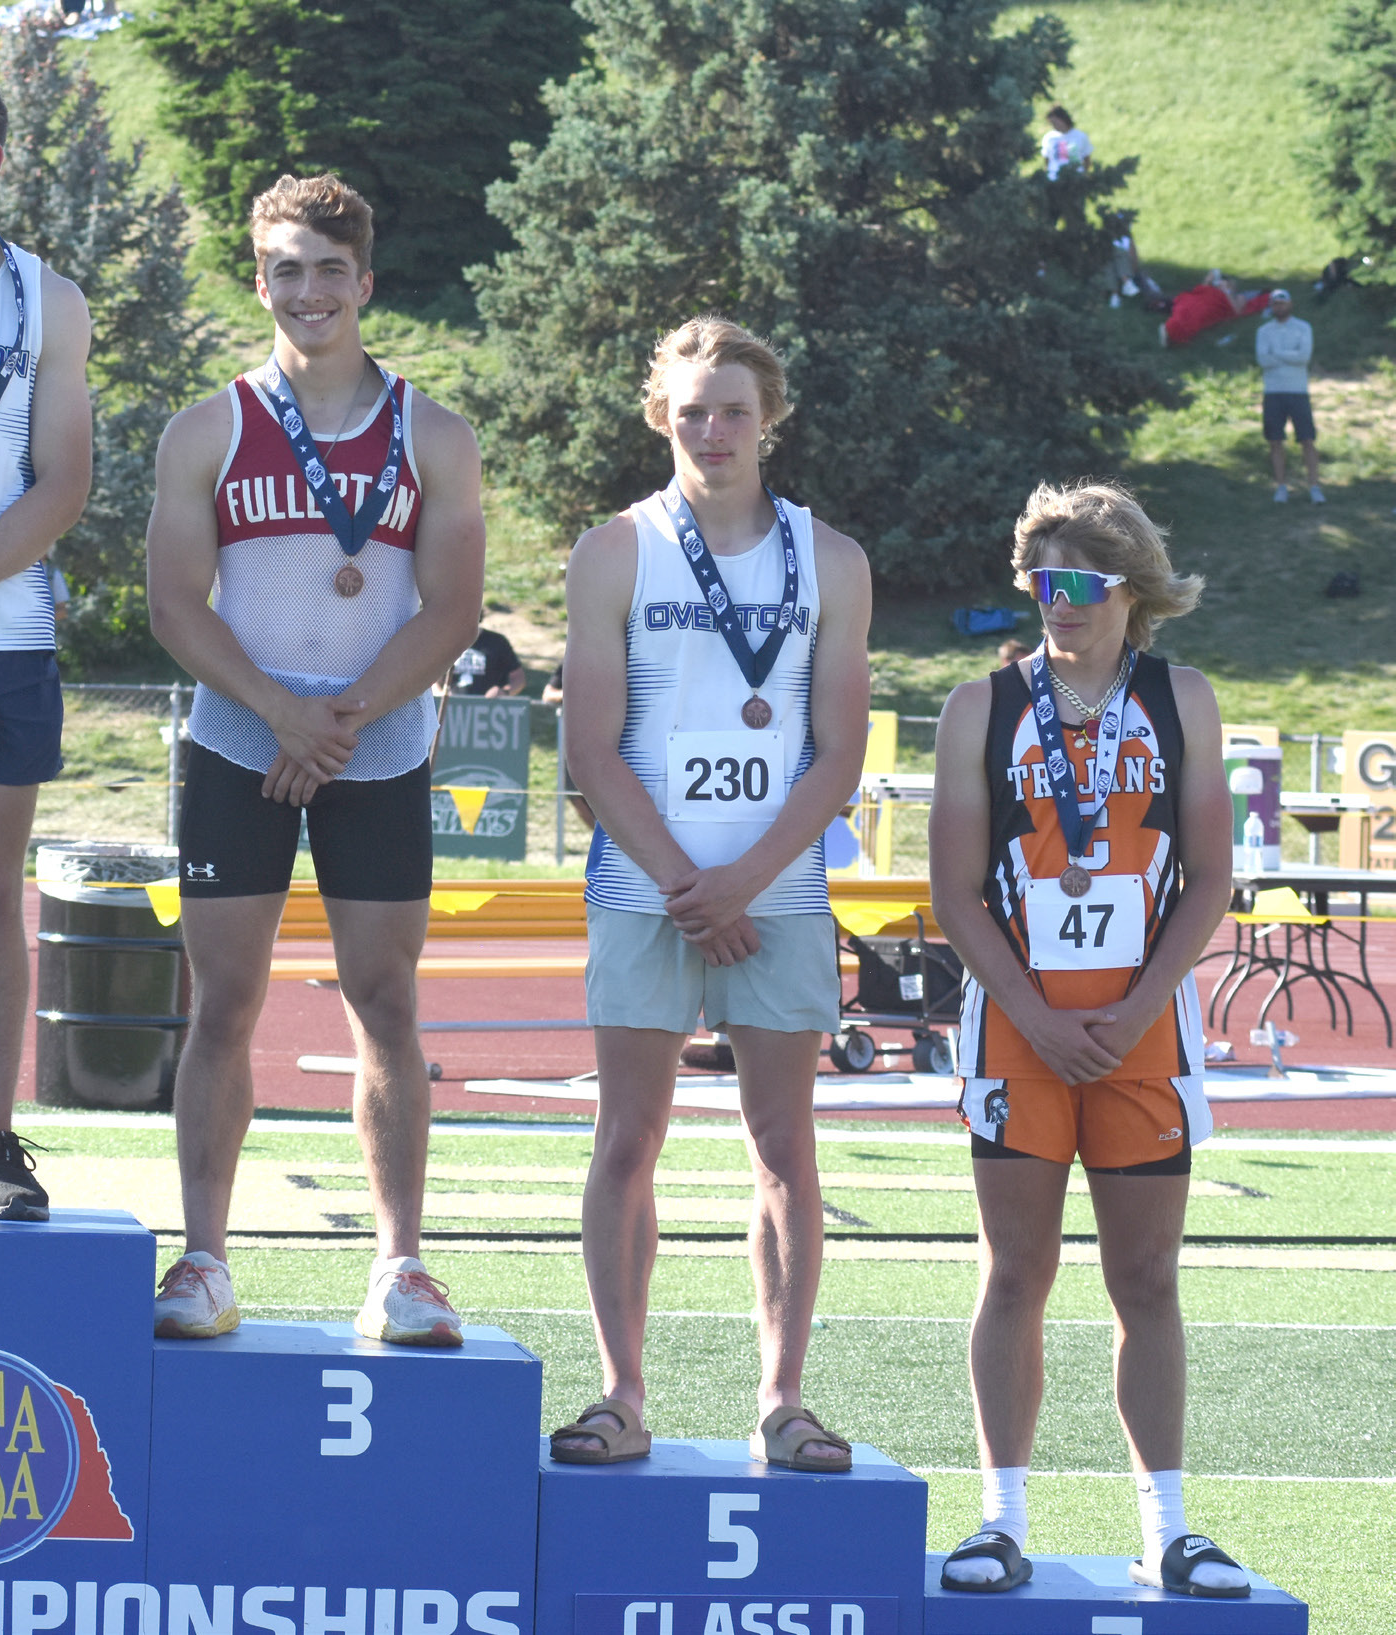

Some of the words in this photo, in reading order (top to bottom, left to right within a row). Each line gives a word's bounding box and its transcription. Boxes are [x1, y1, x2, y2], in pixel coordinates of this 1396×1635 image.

[645, 602, 810, 635] OVETON
[437, 704, 526, 750] WEST
[685, 757, 769, 802] 230
[1006, 756, 1166, 801] TRJNS
[1059, 904, 1115, 949] 47
[320, 1370, 373, 1456] 3
[707, 1492, 760, 1579] 5
